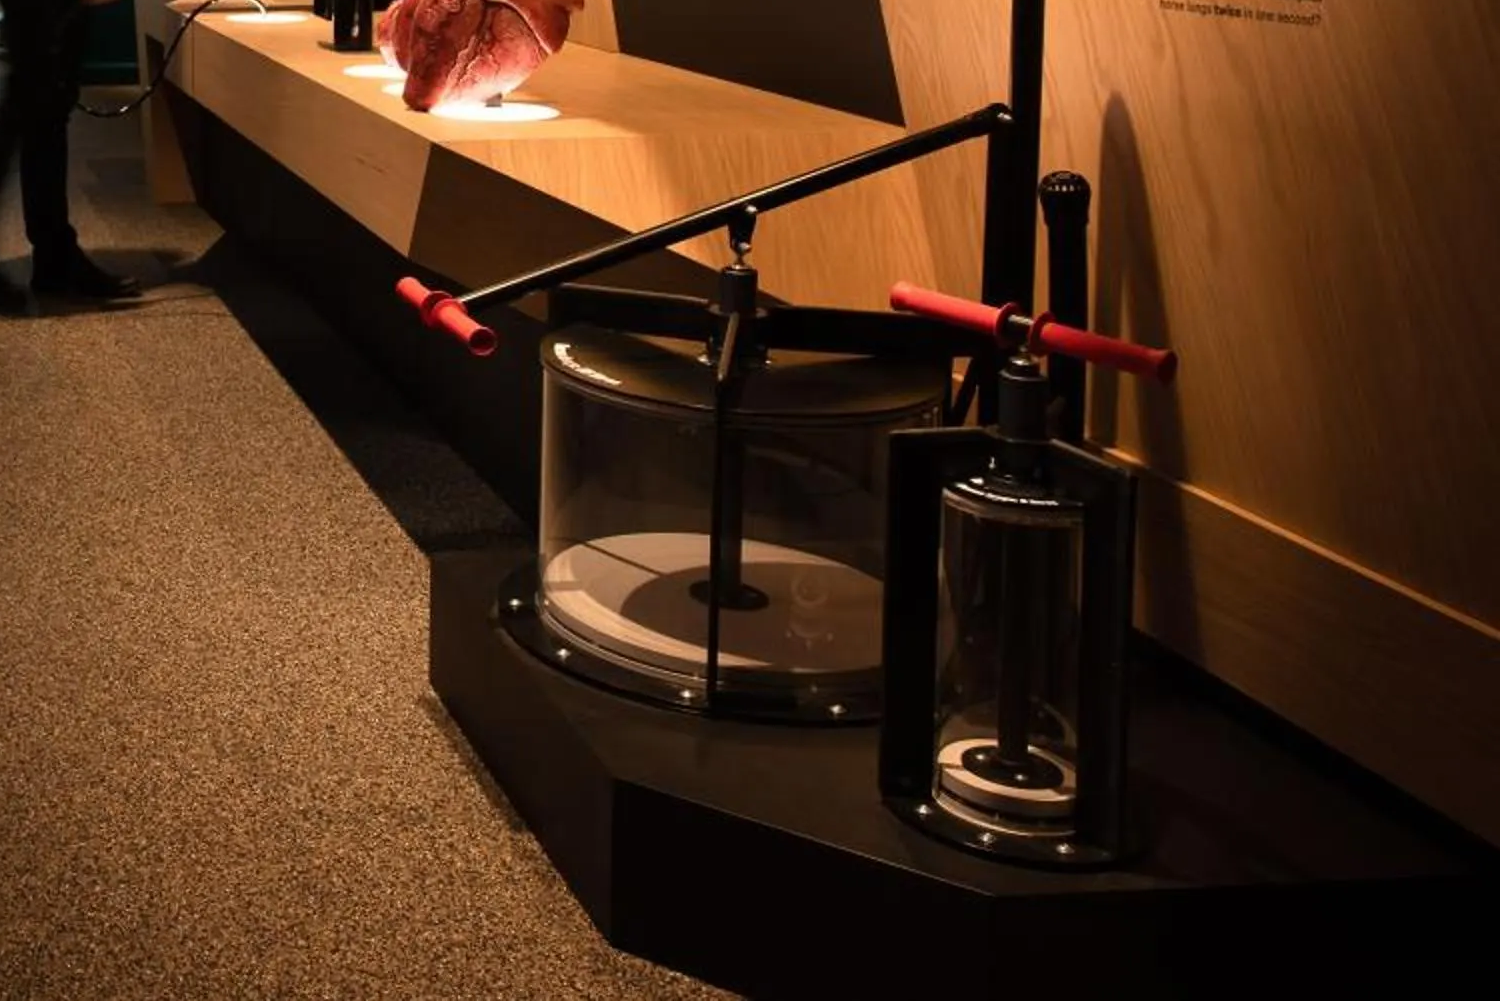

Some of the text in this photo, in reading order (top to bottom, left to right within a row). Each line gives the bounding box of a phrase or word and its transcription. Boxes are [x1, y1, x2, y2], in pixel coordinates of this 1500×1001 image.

[1186, 0, 1212, 16] lungs
[1214, 3, 1242, 18] twice
[1244, 6, 1253, 20] in
[1277, 11, 1322, 27] second?
